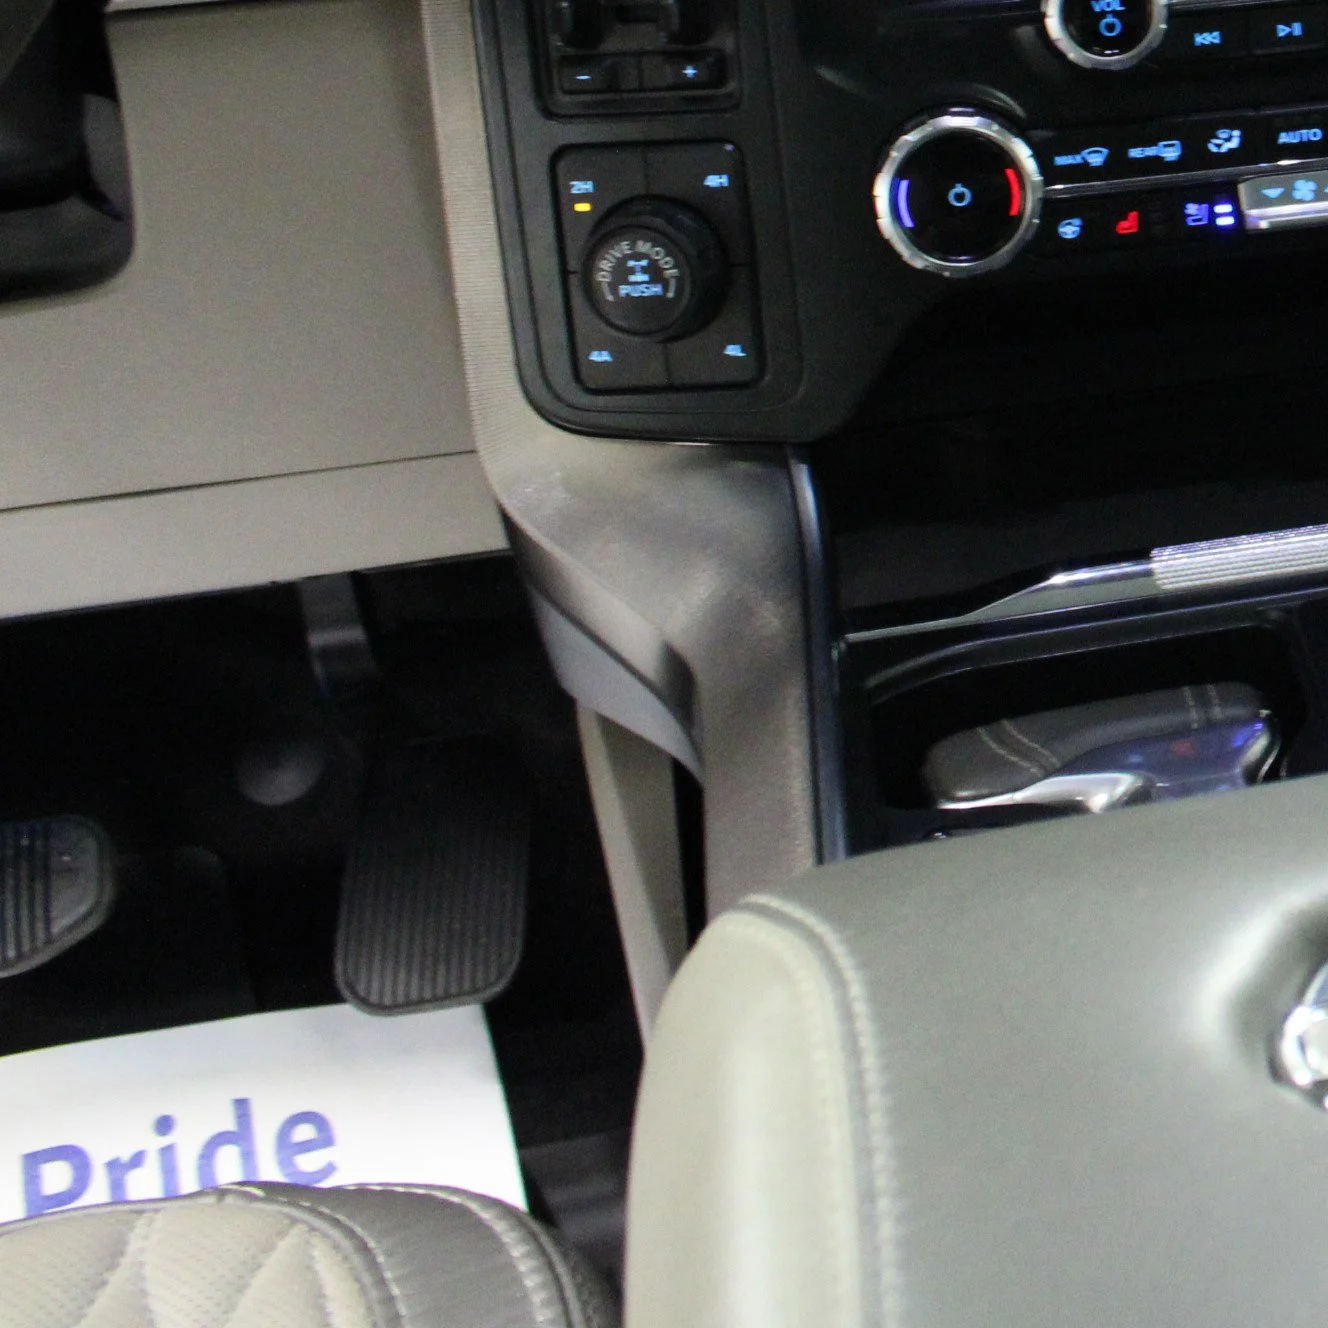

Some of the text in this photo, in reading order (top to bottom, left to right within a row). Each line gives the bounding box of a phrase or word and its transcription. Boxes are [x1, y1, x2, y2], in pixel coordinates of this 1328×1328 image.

[1091, 0, 1125, 12] VOL
[1277, 128, 1323, 145] AUTO
[595, 240, 633, 282] DRIVE
[634, 239, 681, 280] MODE
[619, 284, 663, 297] PUSH
[21, 1097, 338, 1217] Pride
